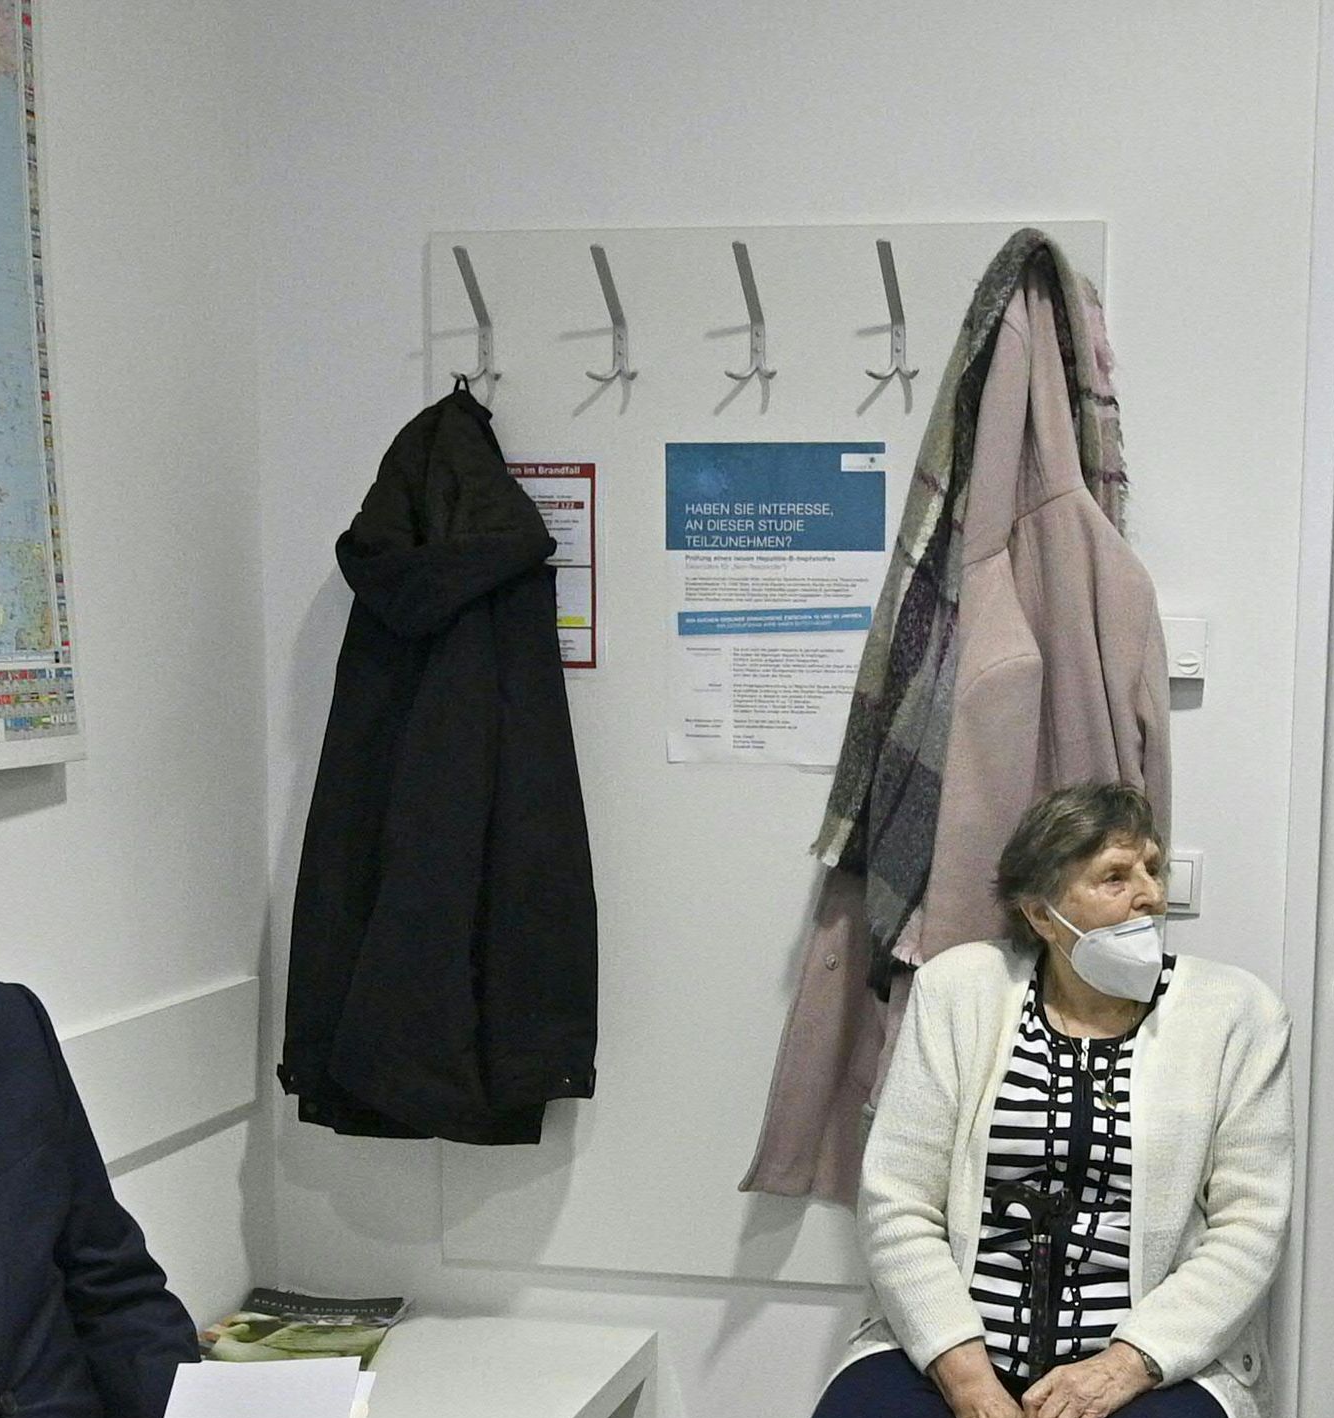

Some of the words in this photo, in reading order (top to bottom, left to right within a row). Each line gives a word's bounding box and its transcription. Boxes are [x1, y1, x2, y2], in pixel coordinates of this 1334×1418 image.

[538, 465, 581, 475] Brandfall
[685, 503, 730, 515] HABEN
[733, 503, 755, 515] SIE
[758, 503, 834, 517] INTERESSE,
[685, 519, 703, 531] AN
[707, 519, 755, 531] DIESER
[758, 519, 805, 531] STUDIE
[685, 535, 792, 547] TEILZUNEHMEN?
